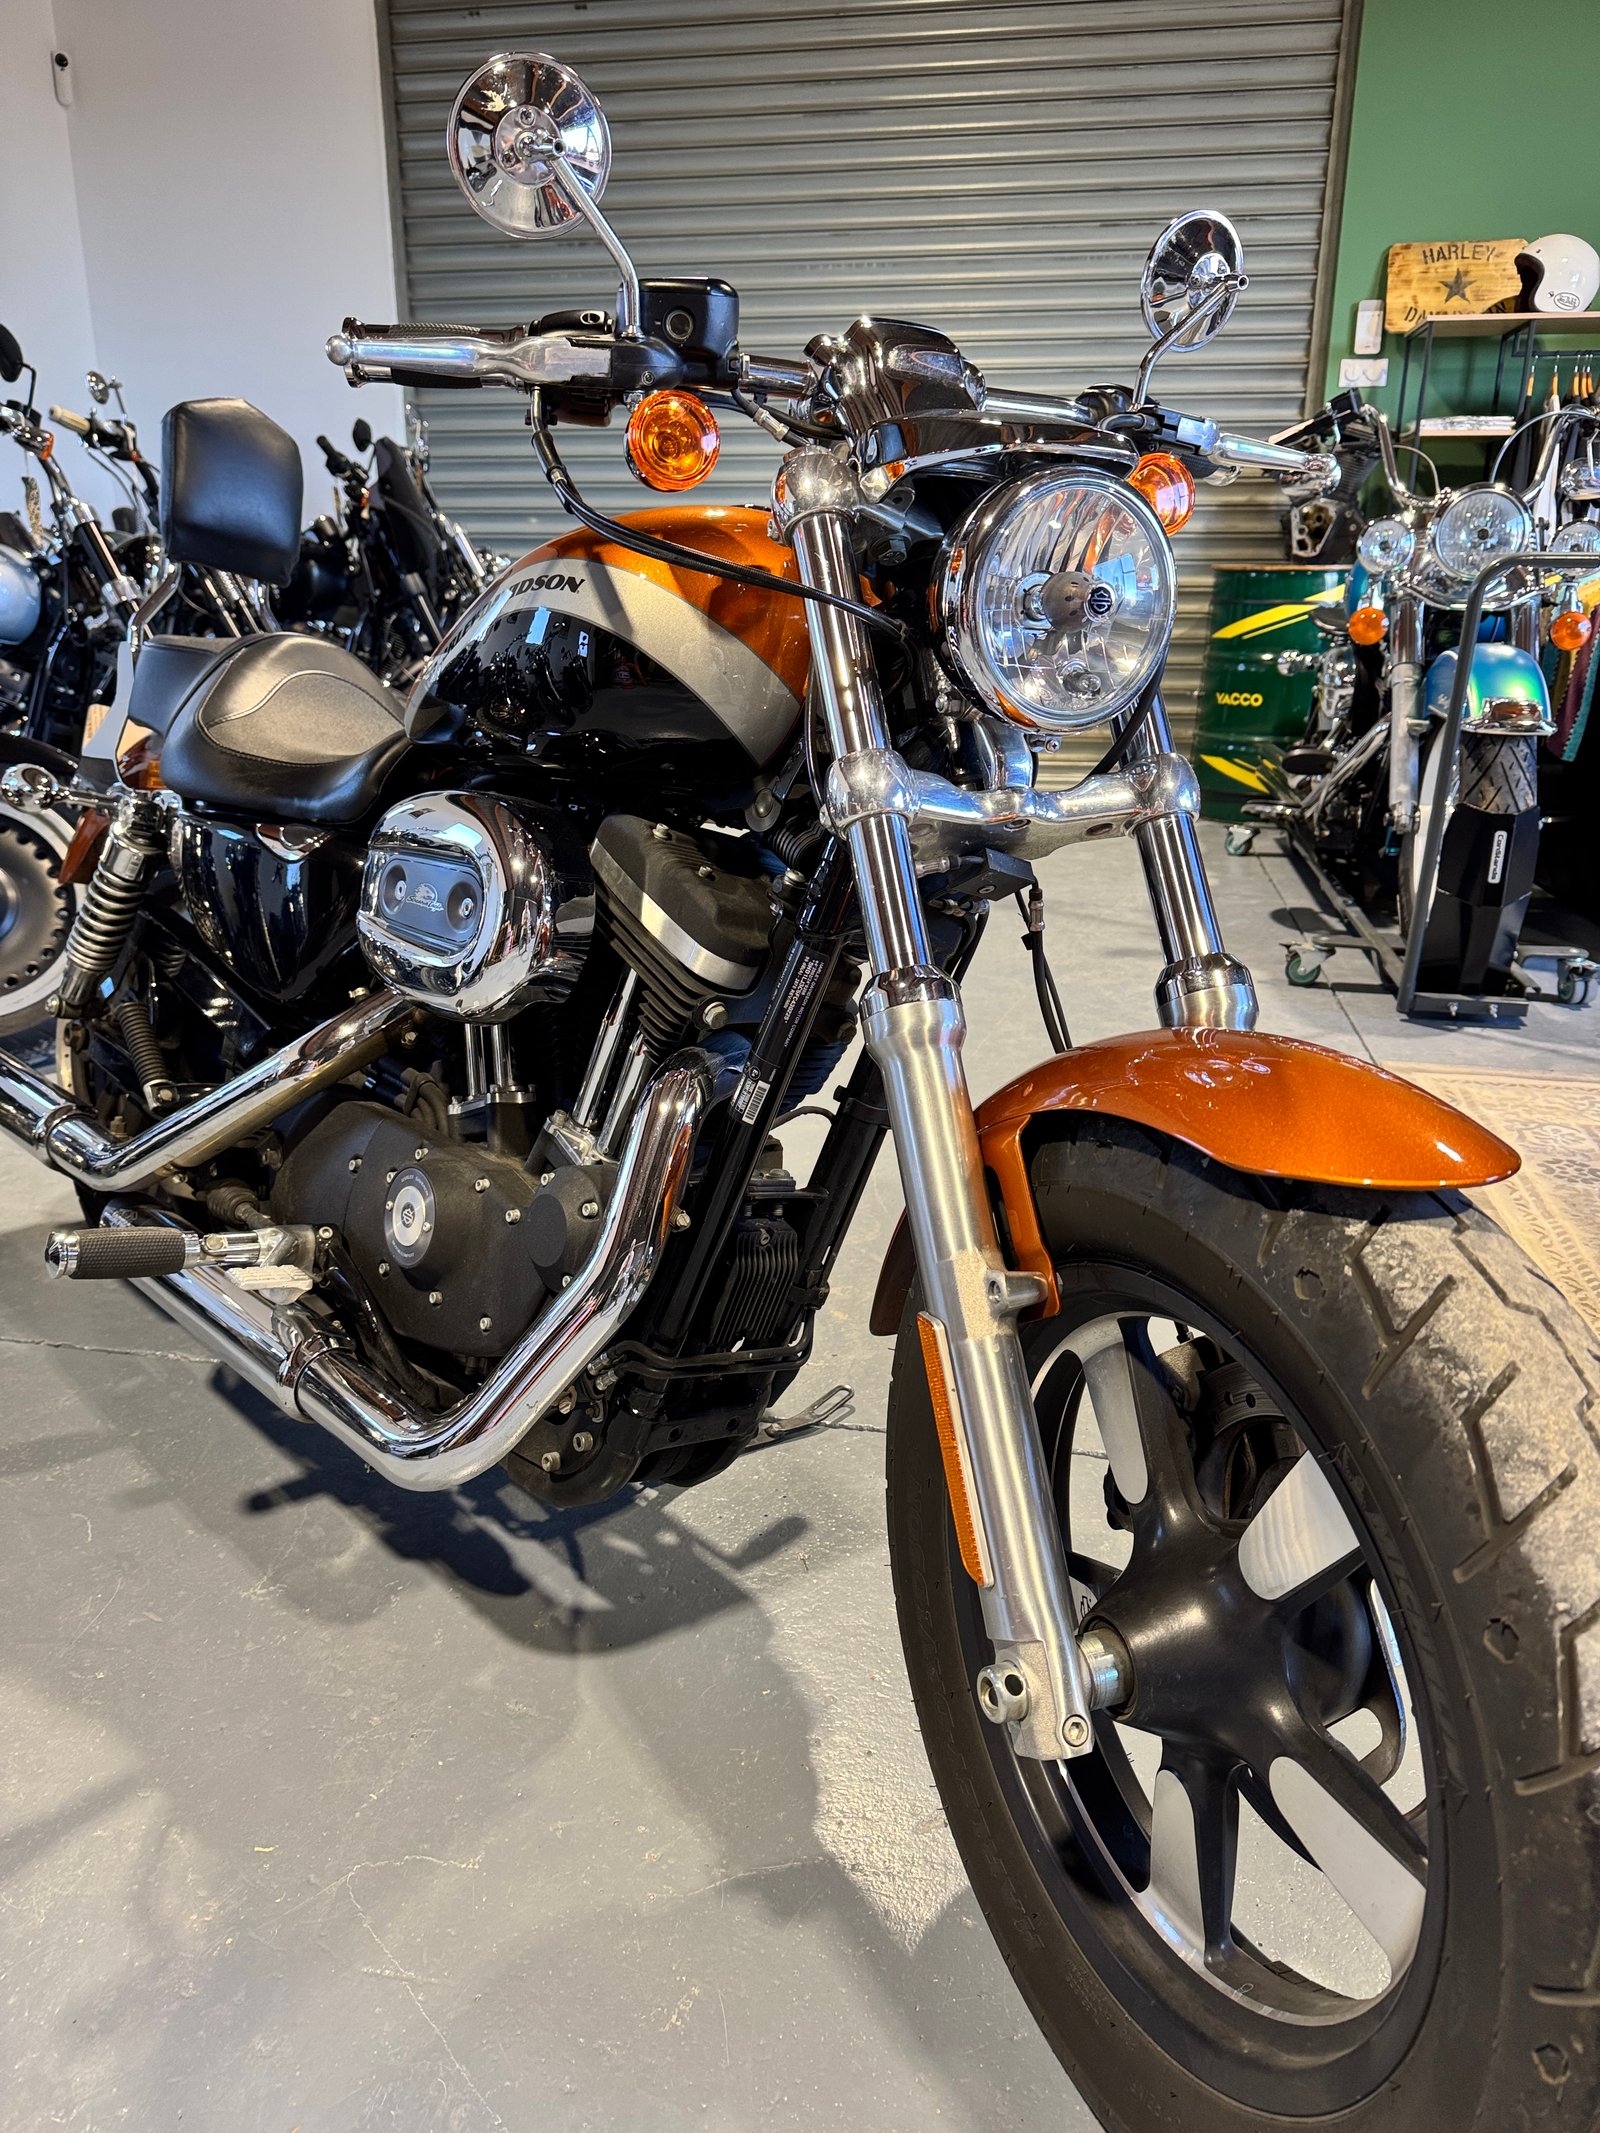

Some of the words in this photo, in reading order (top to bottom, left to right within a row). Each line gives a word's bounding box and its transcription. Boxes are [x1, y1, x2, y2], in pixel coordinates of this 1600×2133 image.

[1422, 243, 1496, 265] HARLEY
[1216, 691, 1263, 707] YACCO
[793, 1006, 805, 1025] MOTOR
[784, 1024, 797, 1048] COMPANY
